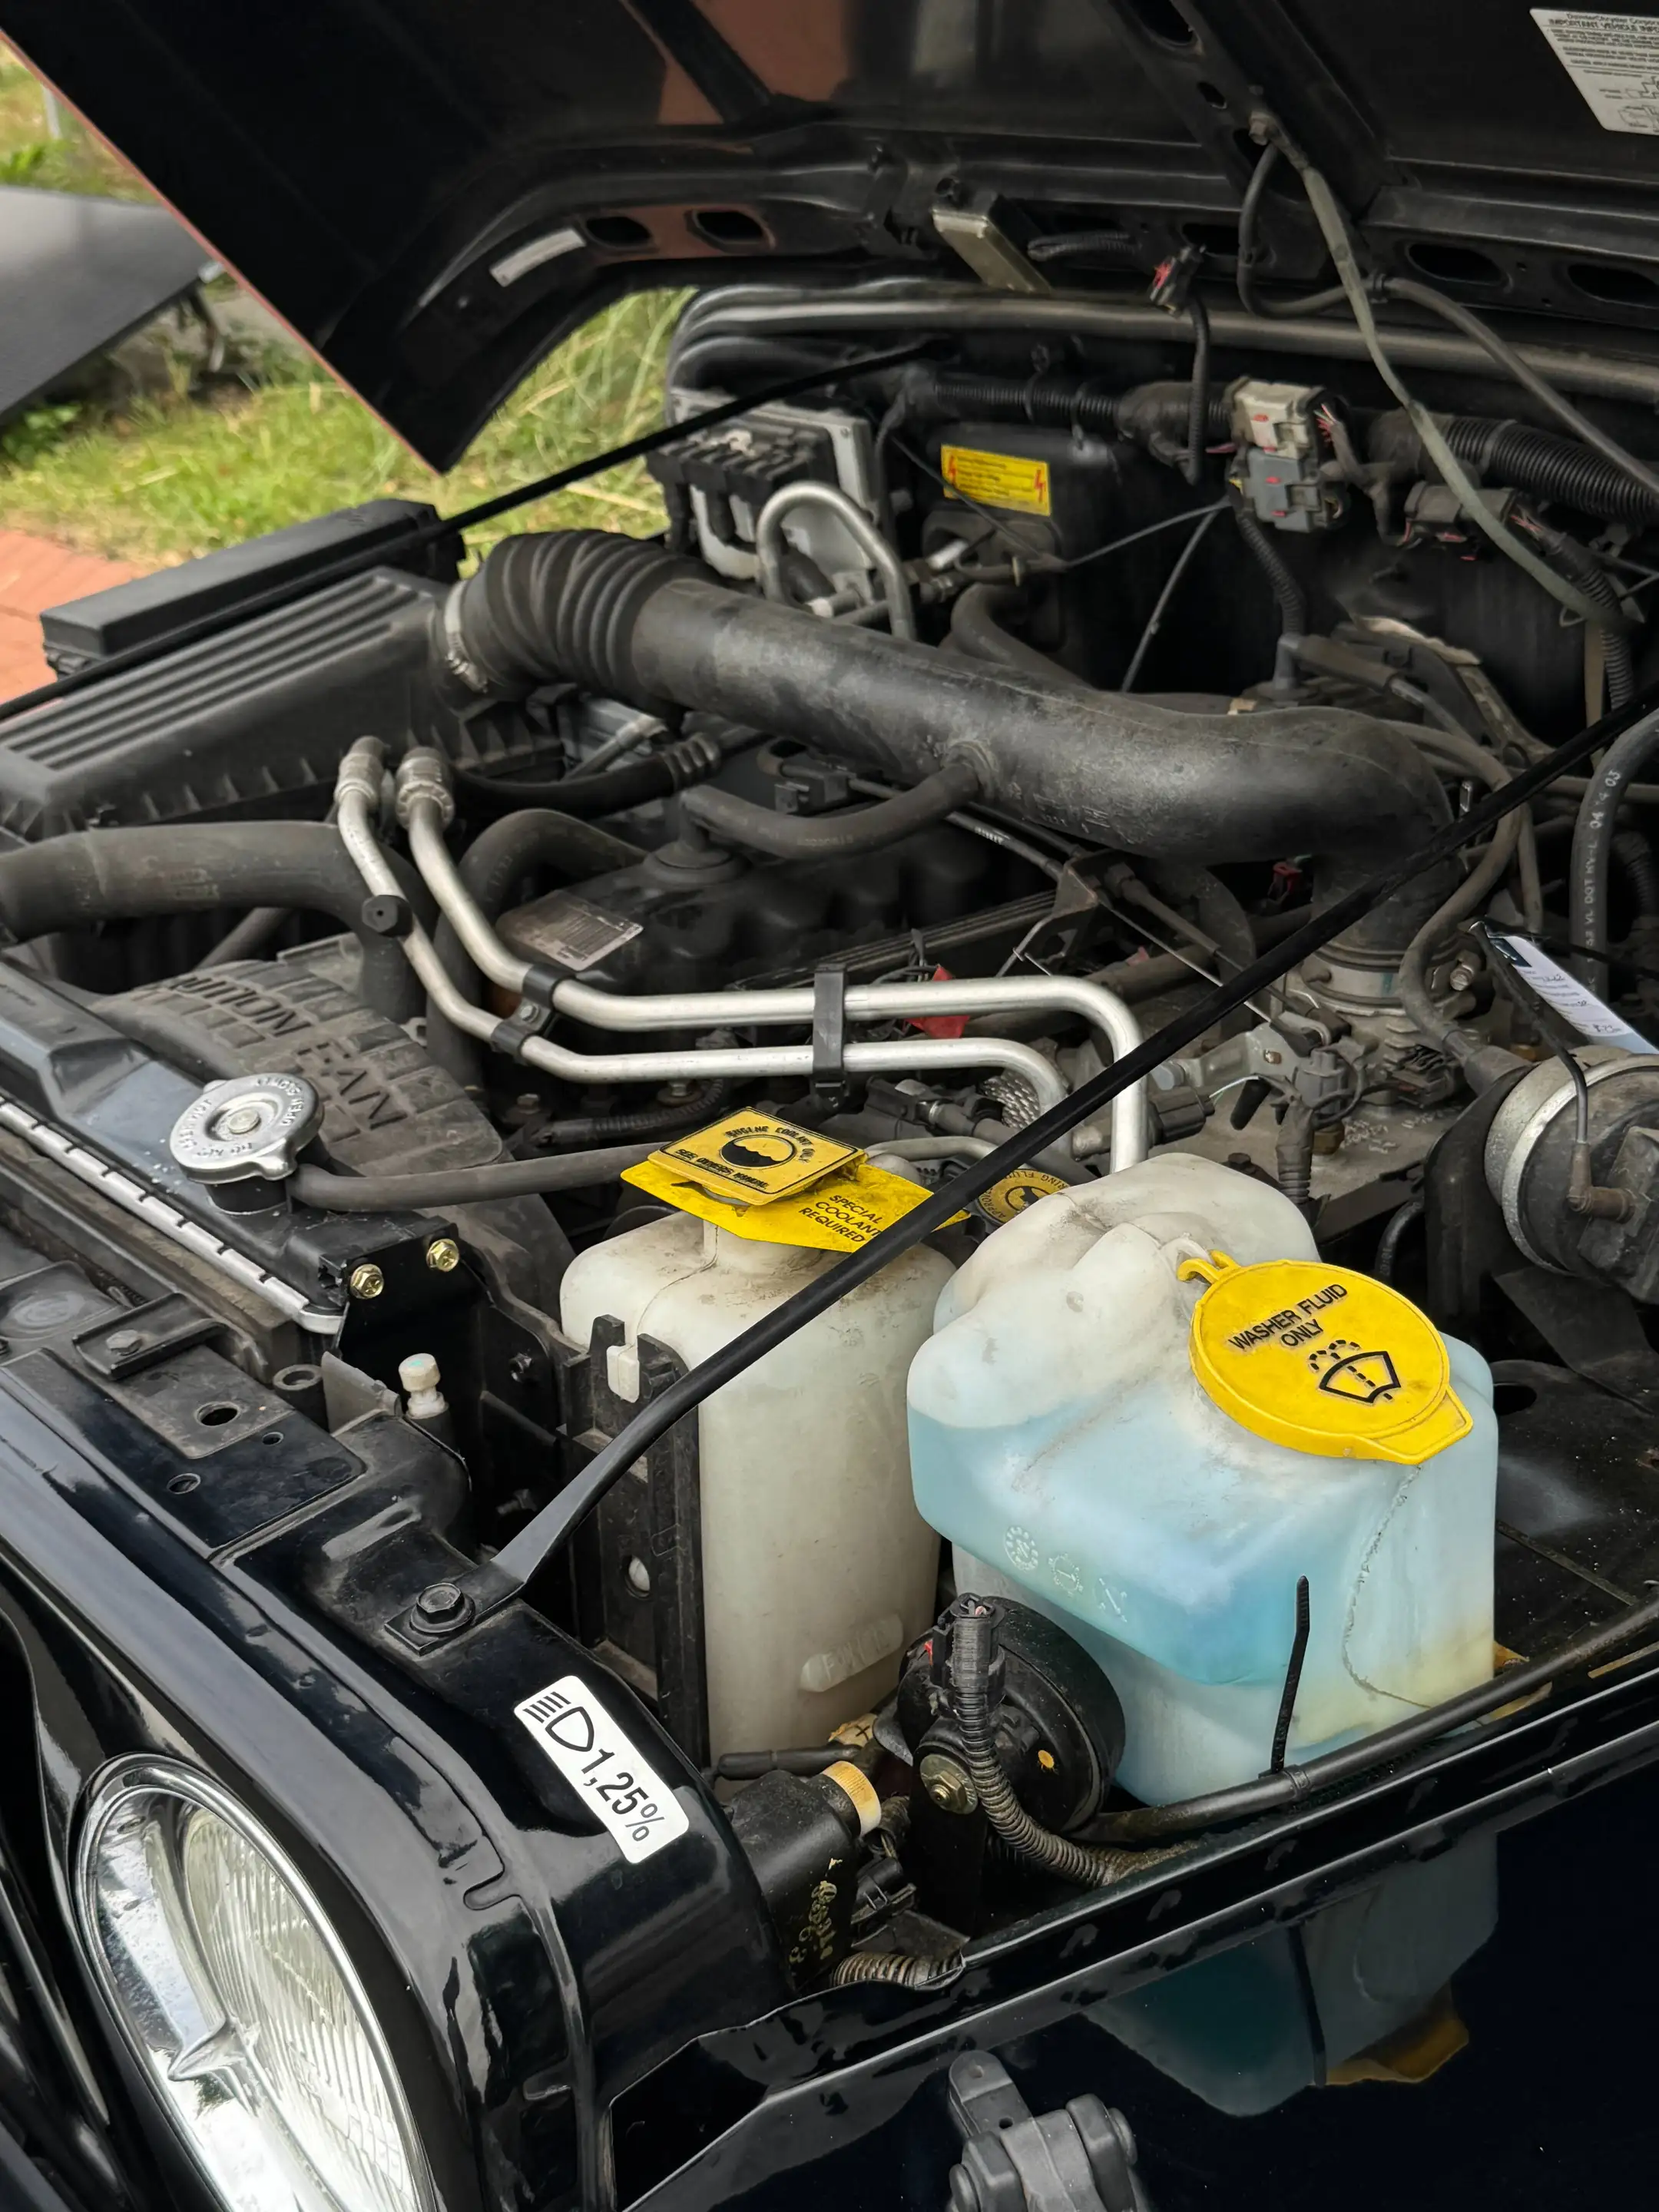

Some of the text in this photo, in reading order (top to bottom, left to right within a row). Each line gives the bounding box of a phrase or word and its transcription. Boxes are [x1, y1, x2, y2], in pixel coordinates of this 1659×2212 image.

[295, 1041, 409, 1131] FAN
[725, 1126, 770, 1137] ENGINE
[775, 1127, 813, 1146] COOLANT
[1041, 1174, 1068, 1190] RING
[799, 1207, 866, 1243] REQUIRED
[815, 1201, 882, 1237] COOLANT
[829, 1194, 883, 1224] SPECIAL
[1228, 1283, 1349, 1351] WASHER FLUID
[1281, 1318, 1325, 1348] ONLY
[581, 1748, 666, 1843] 1,25%
